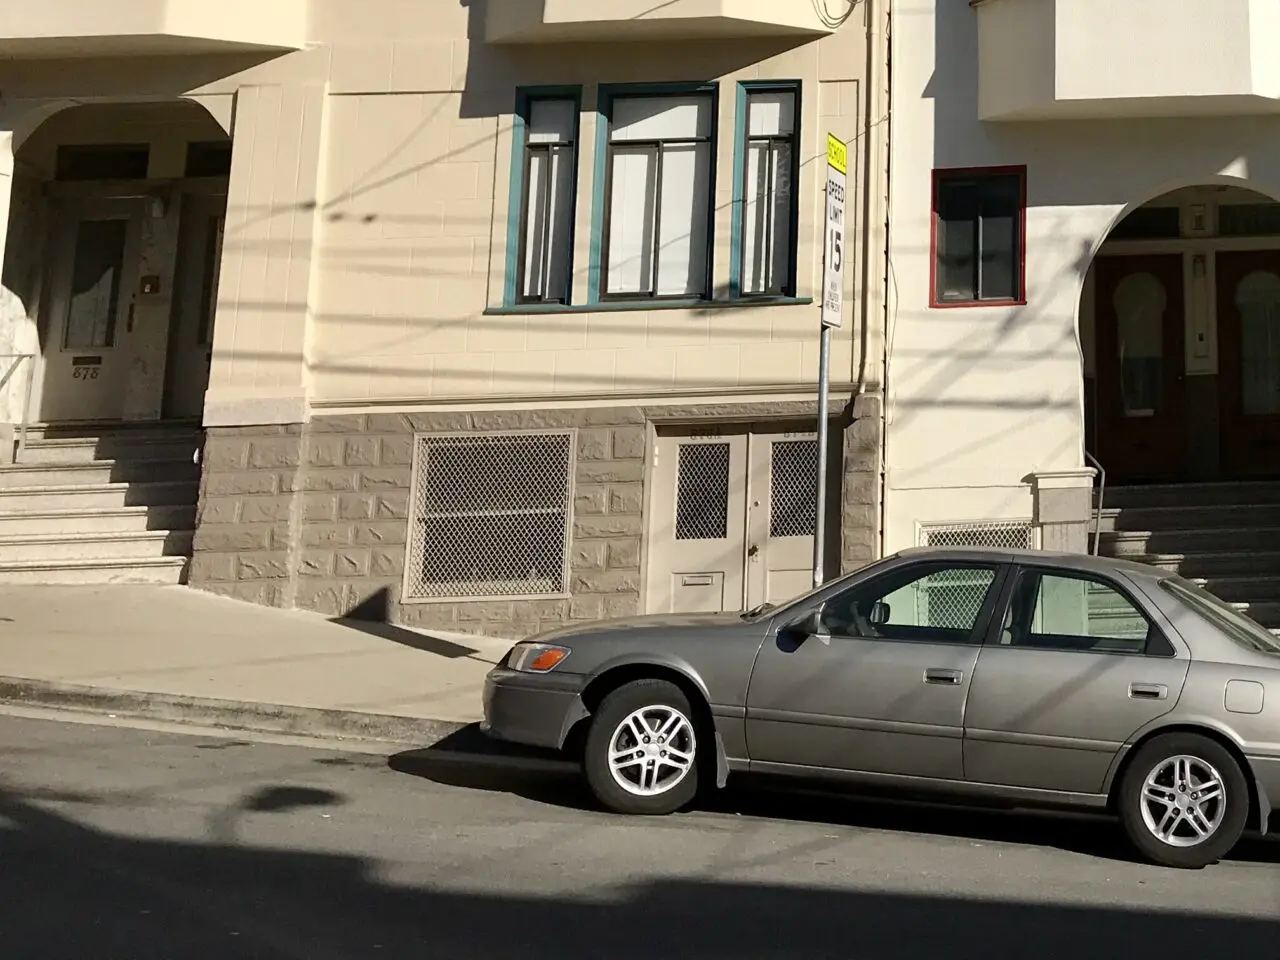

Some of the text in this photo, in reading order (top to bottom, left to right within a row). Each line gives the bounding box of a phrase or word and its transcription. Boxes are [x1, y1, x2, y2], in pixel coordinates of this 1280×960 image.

[829, 179, 844, 203] SPEED
[829, 204, 842, 226] LIMIT
[830, 228, 842, 273] 15
